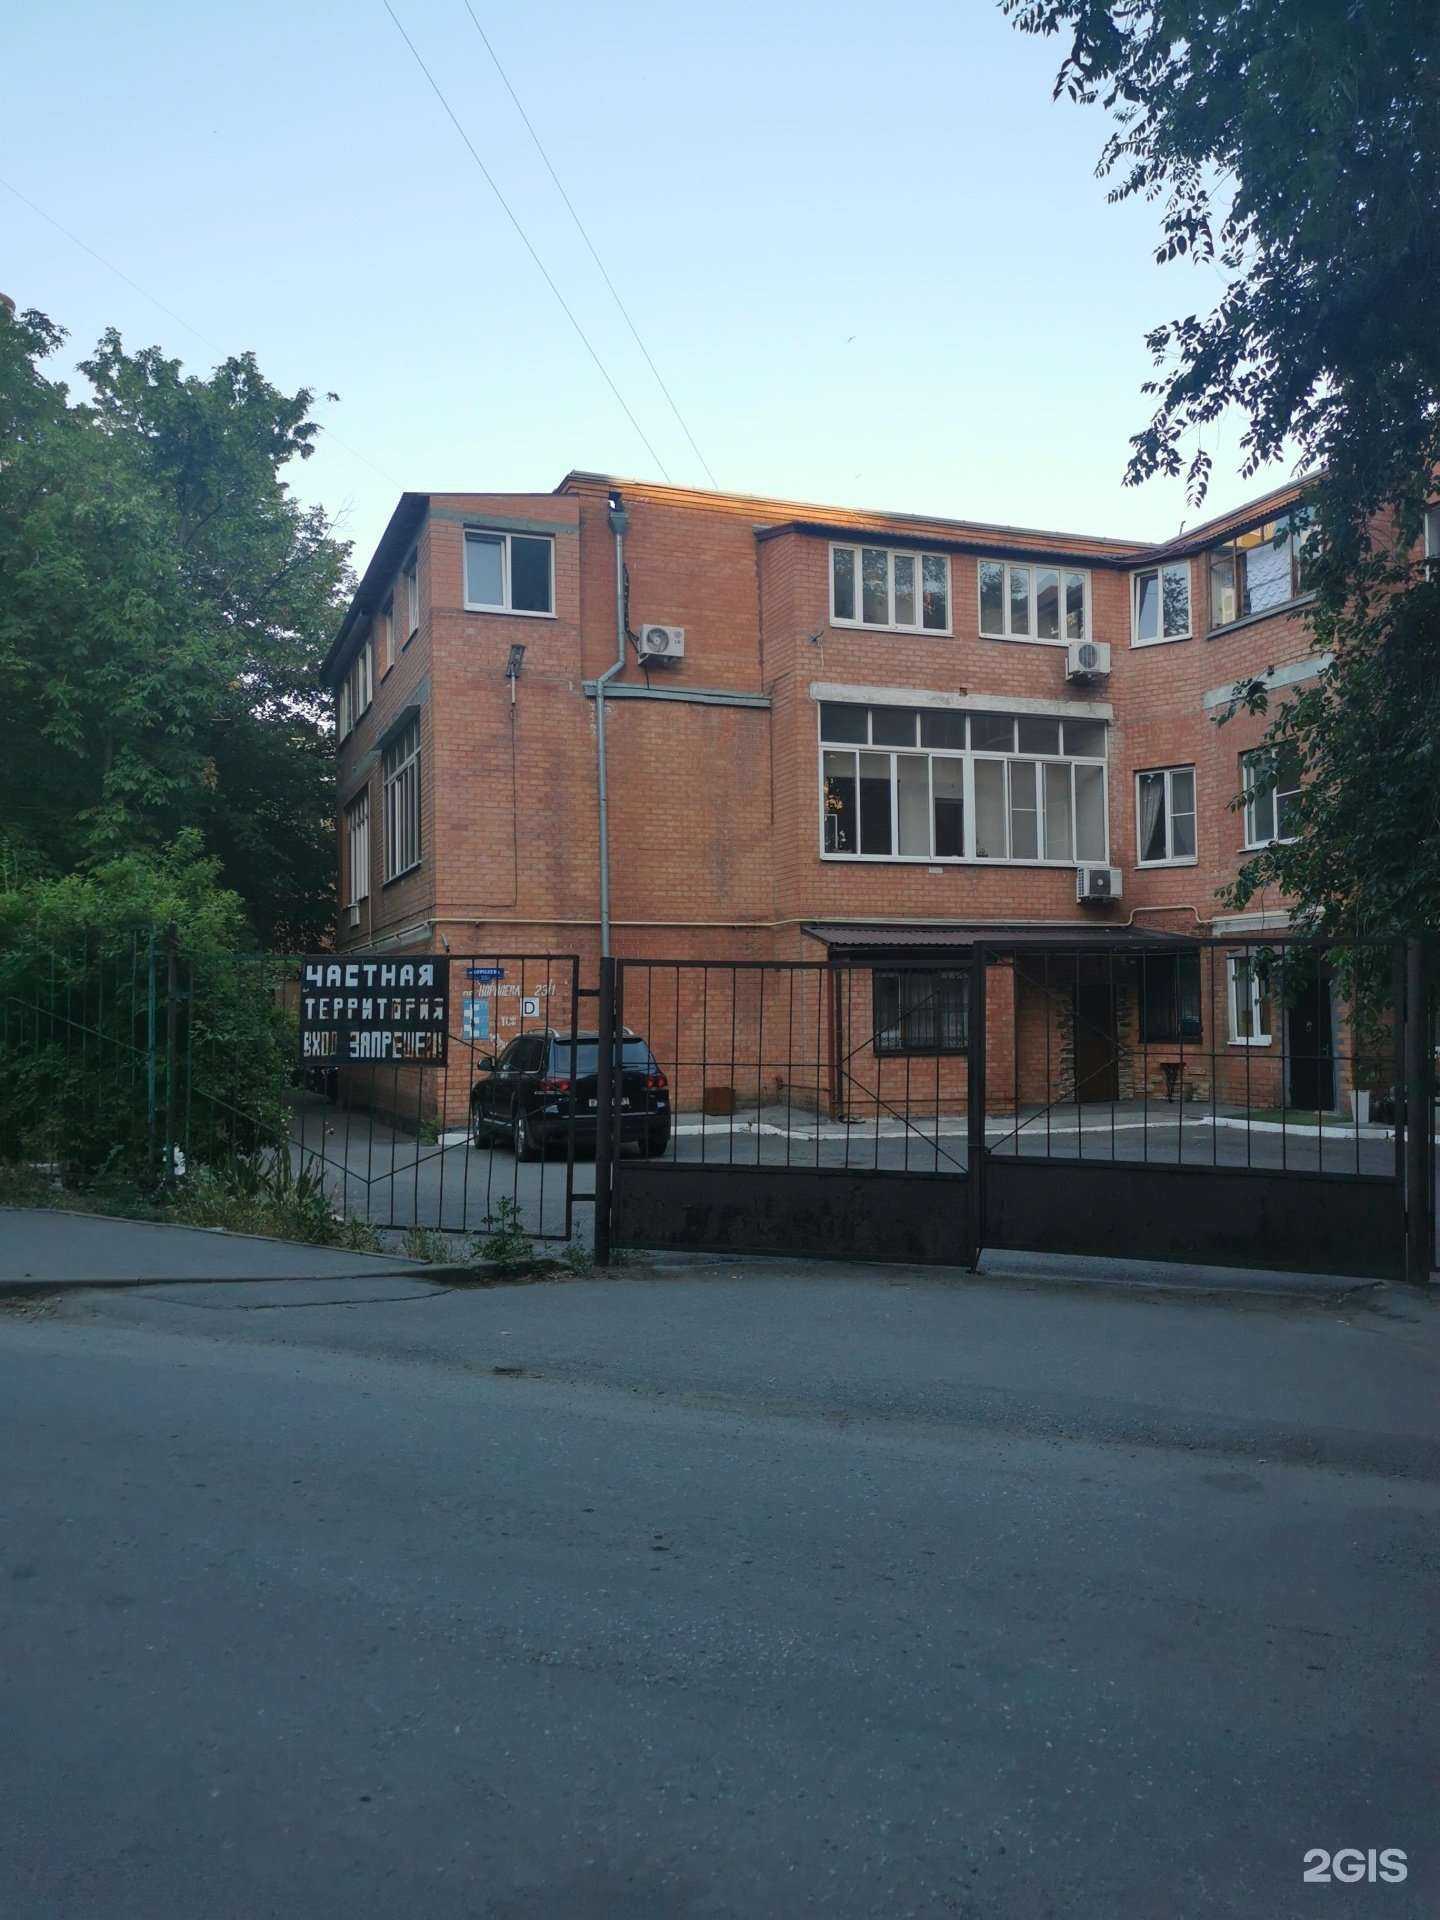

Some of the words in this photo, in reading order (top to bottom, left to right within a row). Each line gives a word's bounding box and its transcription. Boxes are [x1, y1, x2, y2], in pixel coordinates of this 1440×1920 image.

[306, 964, 434, 987] ЧАСТНАЯ
[305, 998, 444, 1020] ТЕРРИТОРИЯ
[524, 1001, 535, 1014] D
